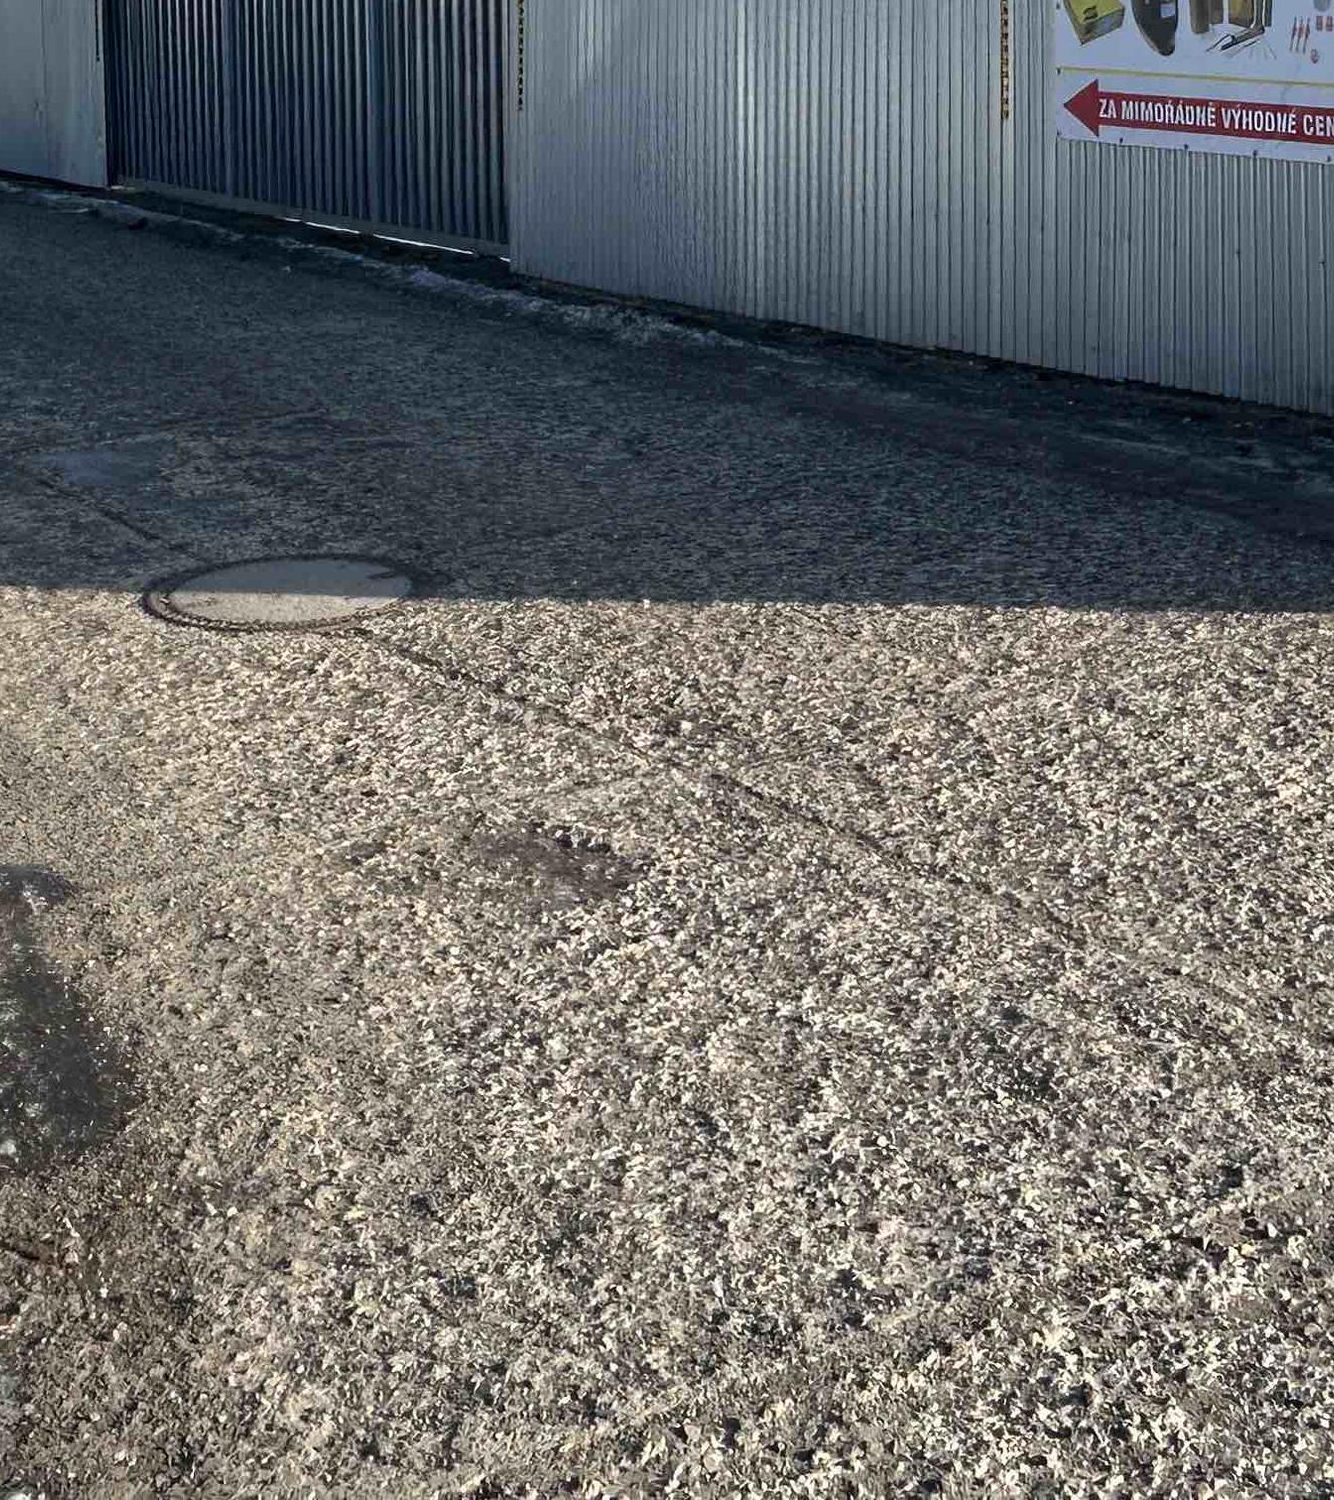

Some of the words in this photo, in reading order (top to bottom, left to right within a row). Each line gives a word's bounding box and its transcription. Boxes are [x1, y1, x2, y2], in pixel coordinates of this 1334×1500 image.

[1099, 98, 1117, 119] ZA
[1121, 100, 1216, 127] MIMOŘÁDNÉ
[1221, 105, 1297, 134] VÝHODNÉ
